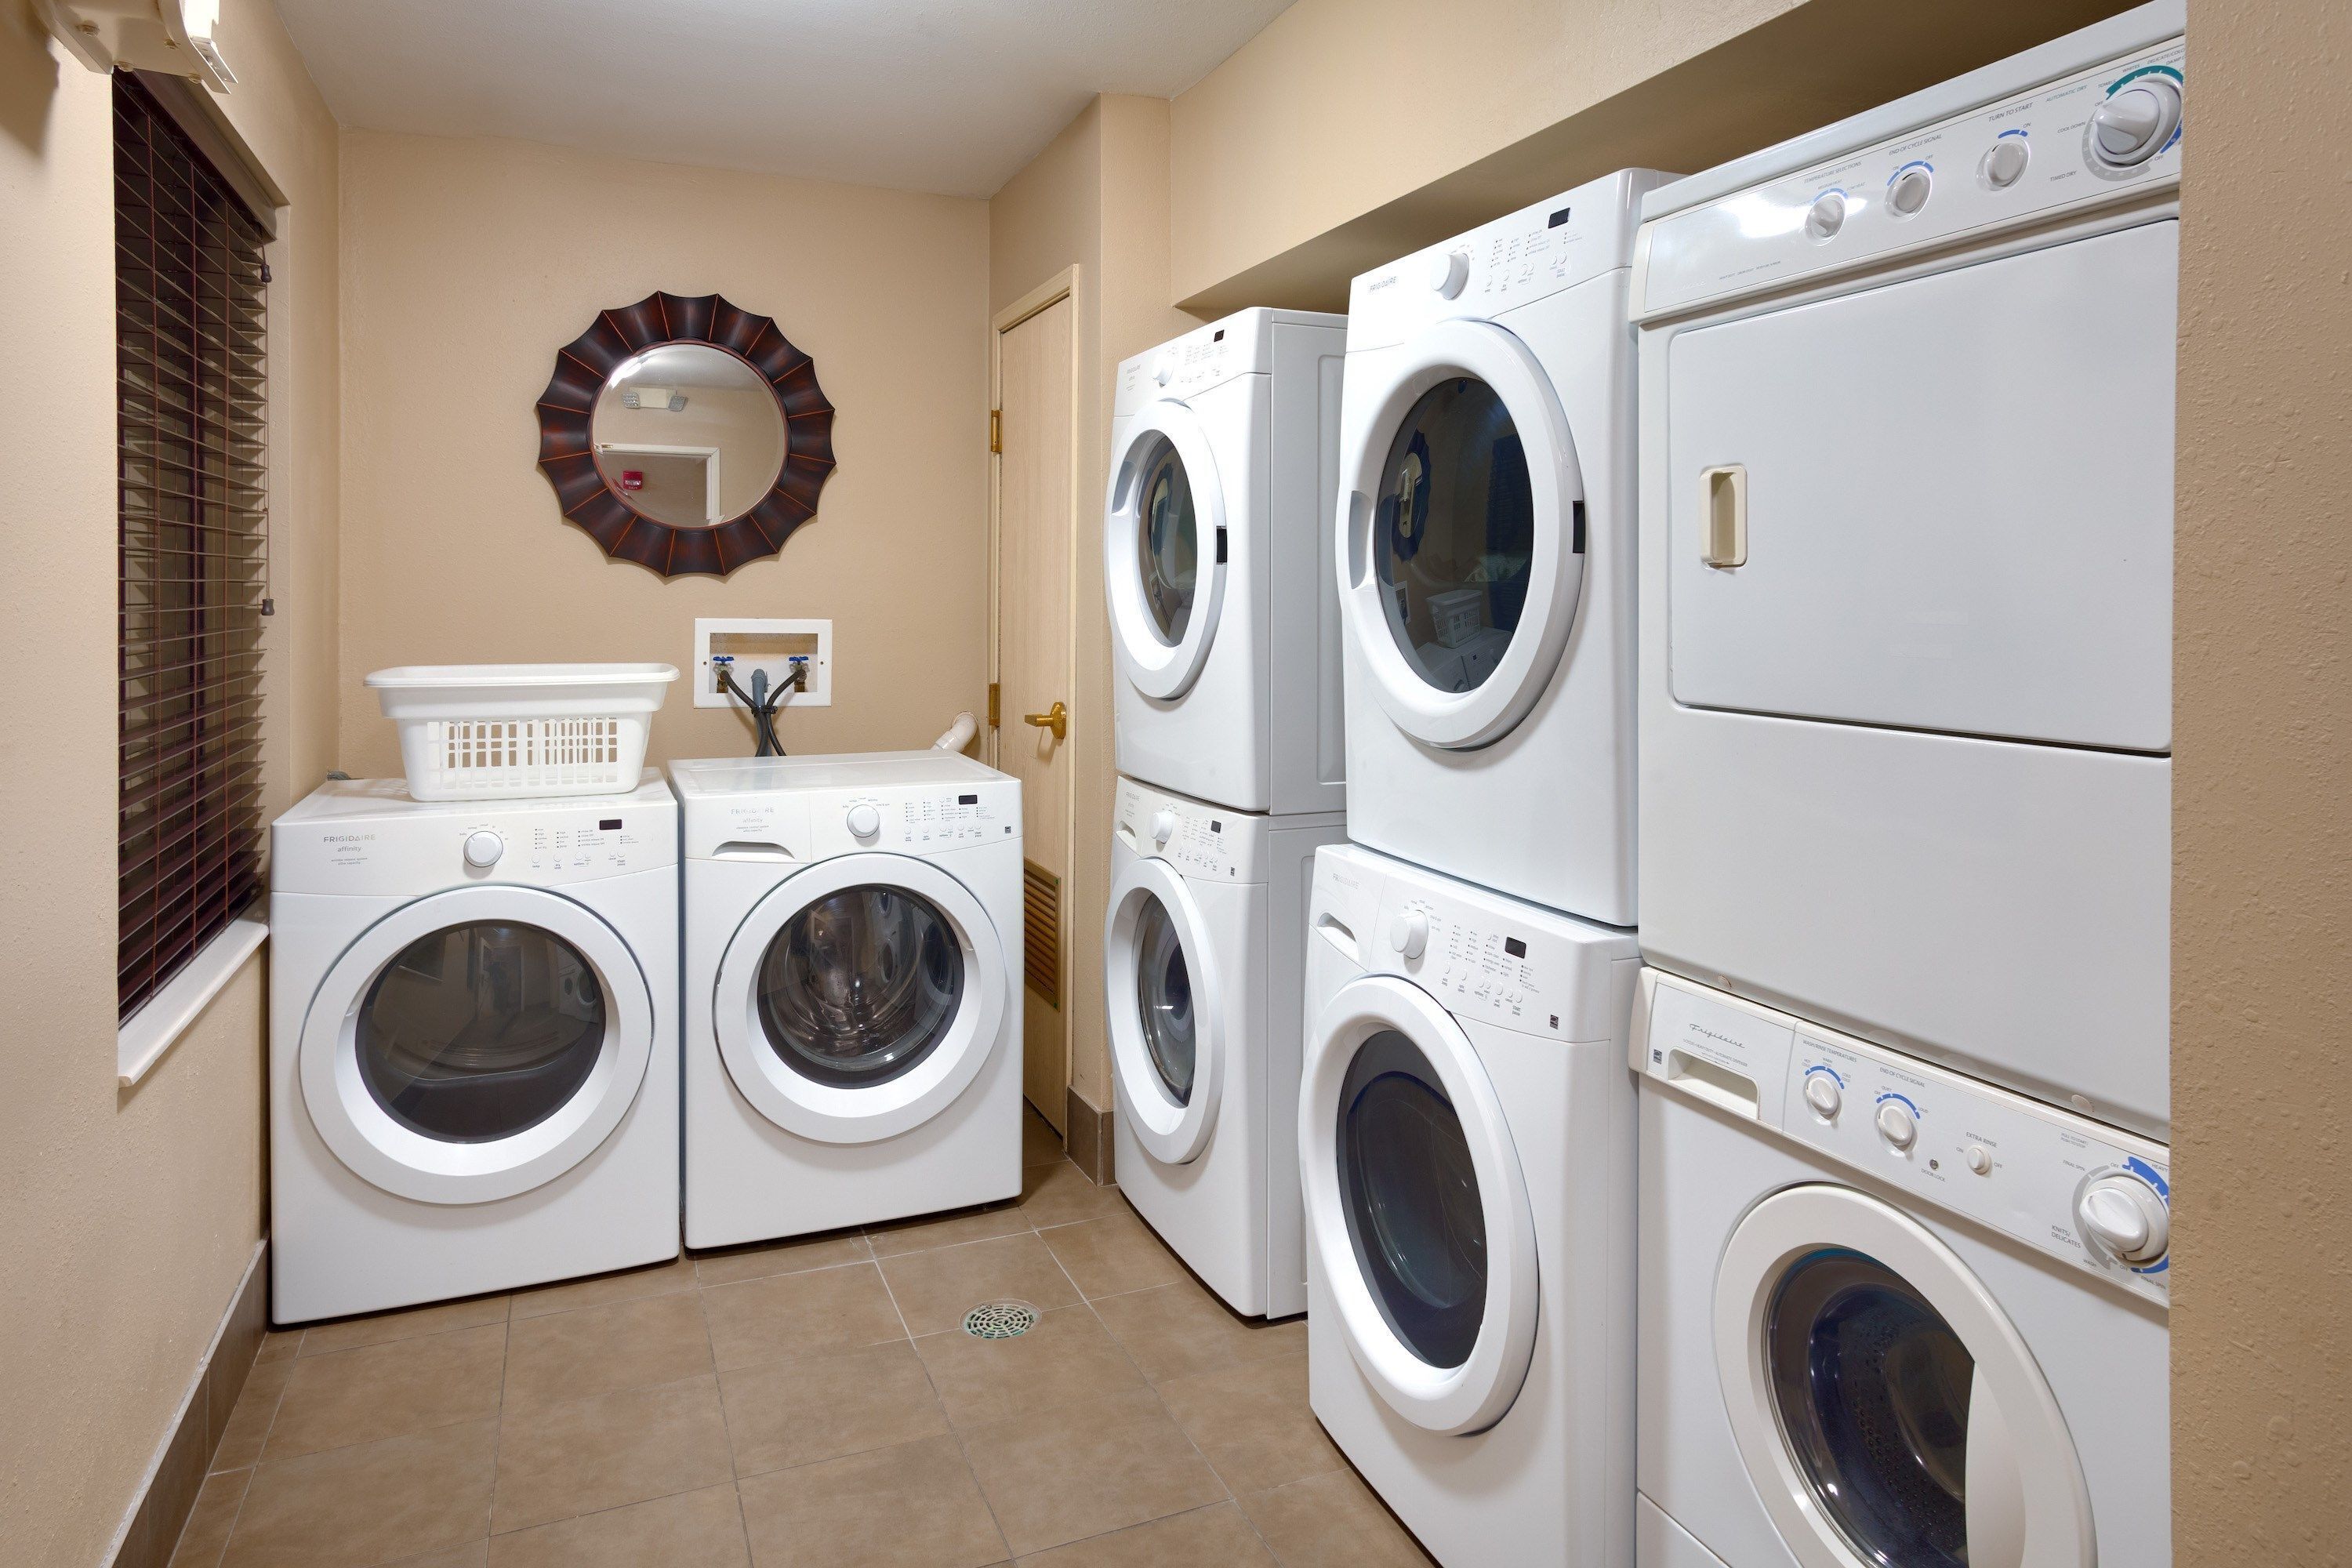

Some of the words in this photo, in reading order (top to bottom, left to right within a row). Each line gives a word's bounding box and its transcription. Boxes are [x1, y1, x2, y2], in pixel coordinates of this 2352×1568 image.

[2122, 64, 2140, 73] WHITES
[2097, 79, 2117, 89] TOWELS
[2045, 88, 2077, 103] AUTOMATIC
[1988, 112, 2005, 122] TURN
[2014, 102, 2034, 114] START
[1907, 140, 1923, 151] CYCLE
[1923, 134, 1943, 144] SIGNAL
[1804, 169, 1836, 183] TEMPERATURE
[1835, 162, 1862, 174] SELECTIONS
[2050, 172, 2066, 182] TIMED
[2066, 170, 2078, 179] DRY
[323, 834, 376, 843] FRIGIDAIRE
[1689, 1023, 1746, 1049] Frigidaire
[1803, 1040, 1828, 1052] WASH/RINSE
[1827, 1048, 1857, 1062] TEMPERATURES
[1896, 1073, 1909, 1082] CYCLE
[1909, 1078, 1926, 1088] SIGNAL
[1965, 1131, 1982, 1142] EXTRA
[1983, 1138, 1998, 1148] RINSE
[2063, 1160, 2076, 1168] FINAL
[2151, 1163, 2169, 1172] HEAVY
[1921, 1168, 1935, 1177] DOOR
[1934, 1174, 1946, 1182] LOCK
[2051, 1224, 2071, 1237] KNITS/
[2051, 1232, 2082, 1249] DELICATES
[2082, 1258, 2097, 1268] WASH
[2140, 1276, 2155, 1285] FINAL
[2154, 1281, 2167, 1290] SPIN
